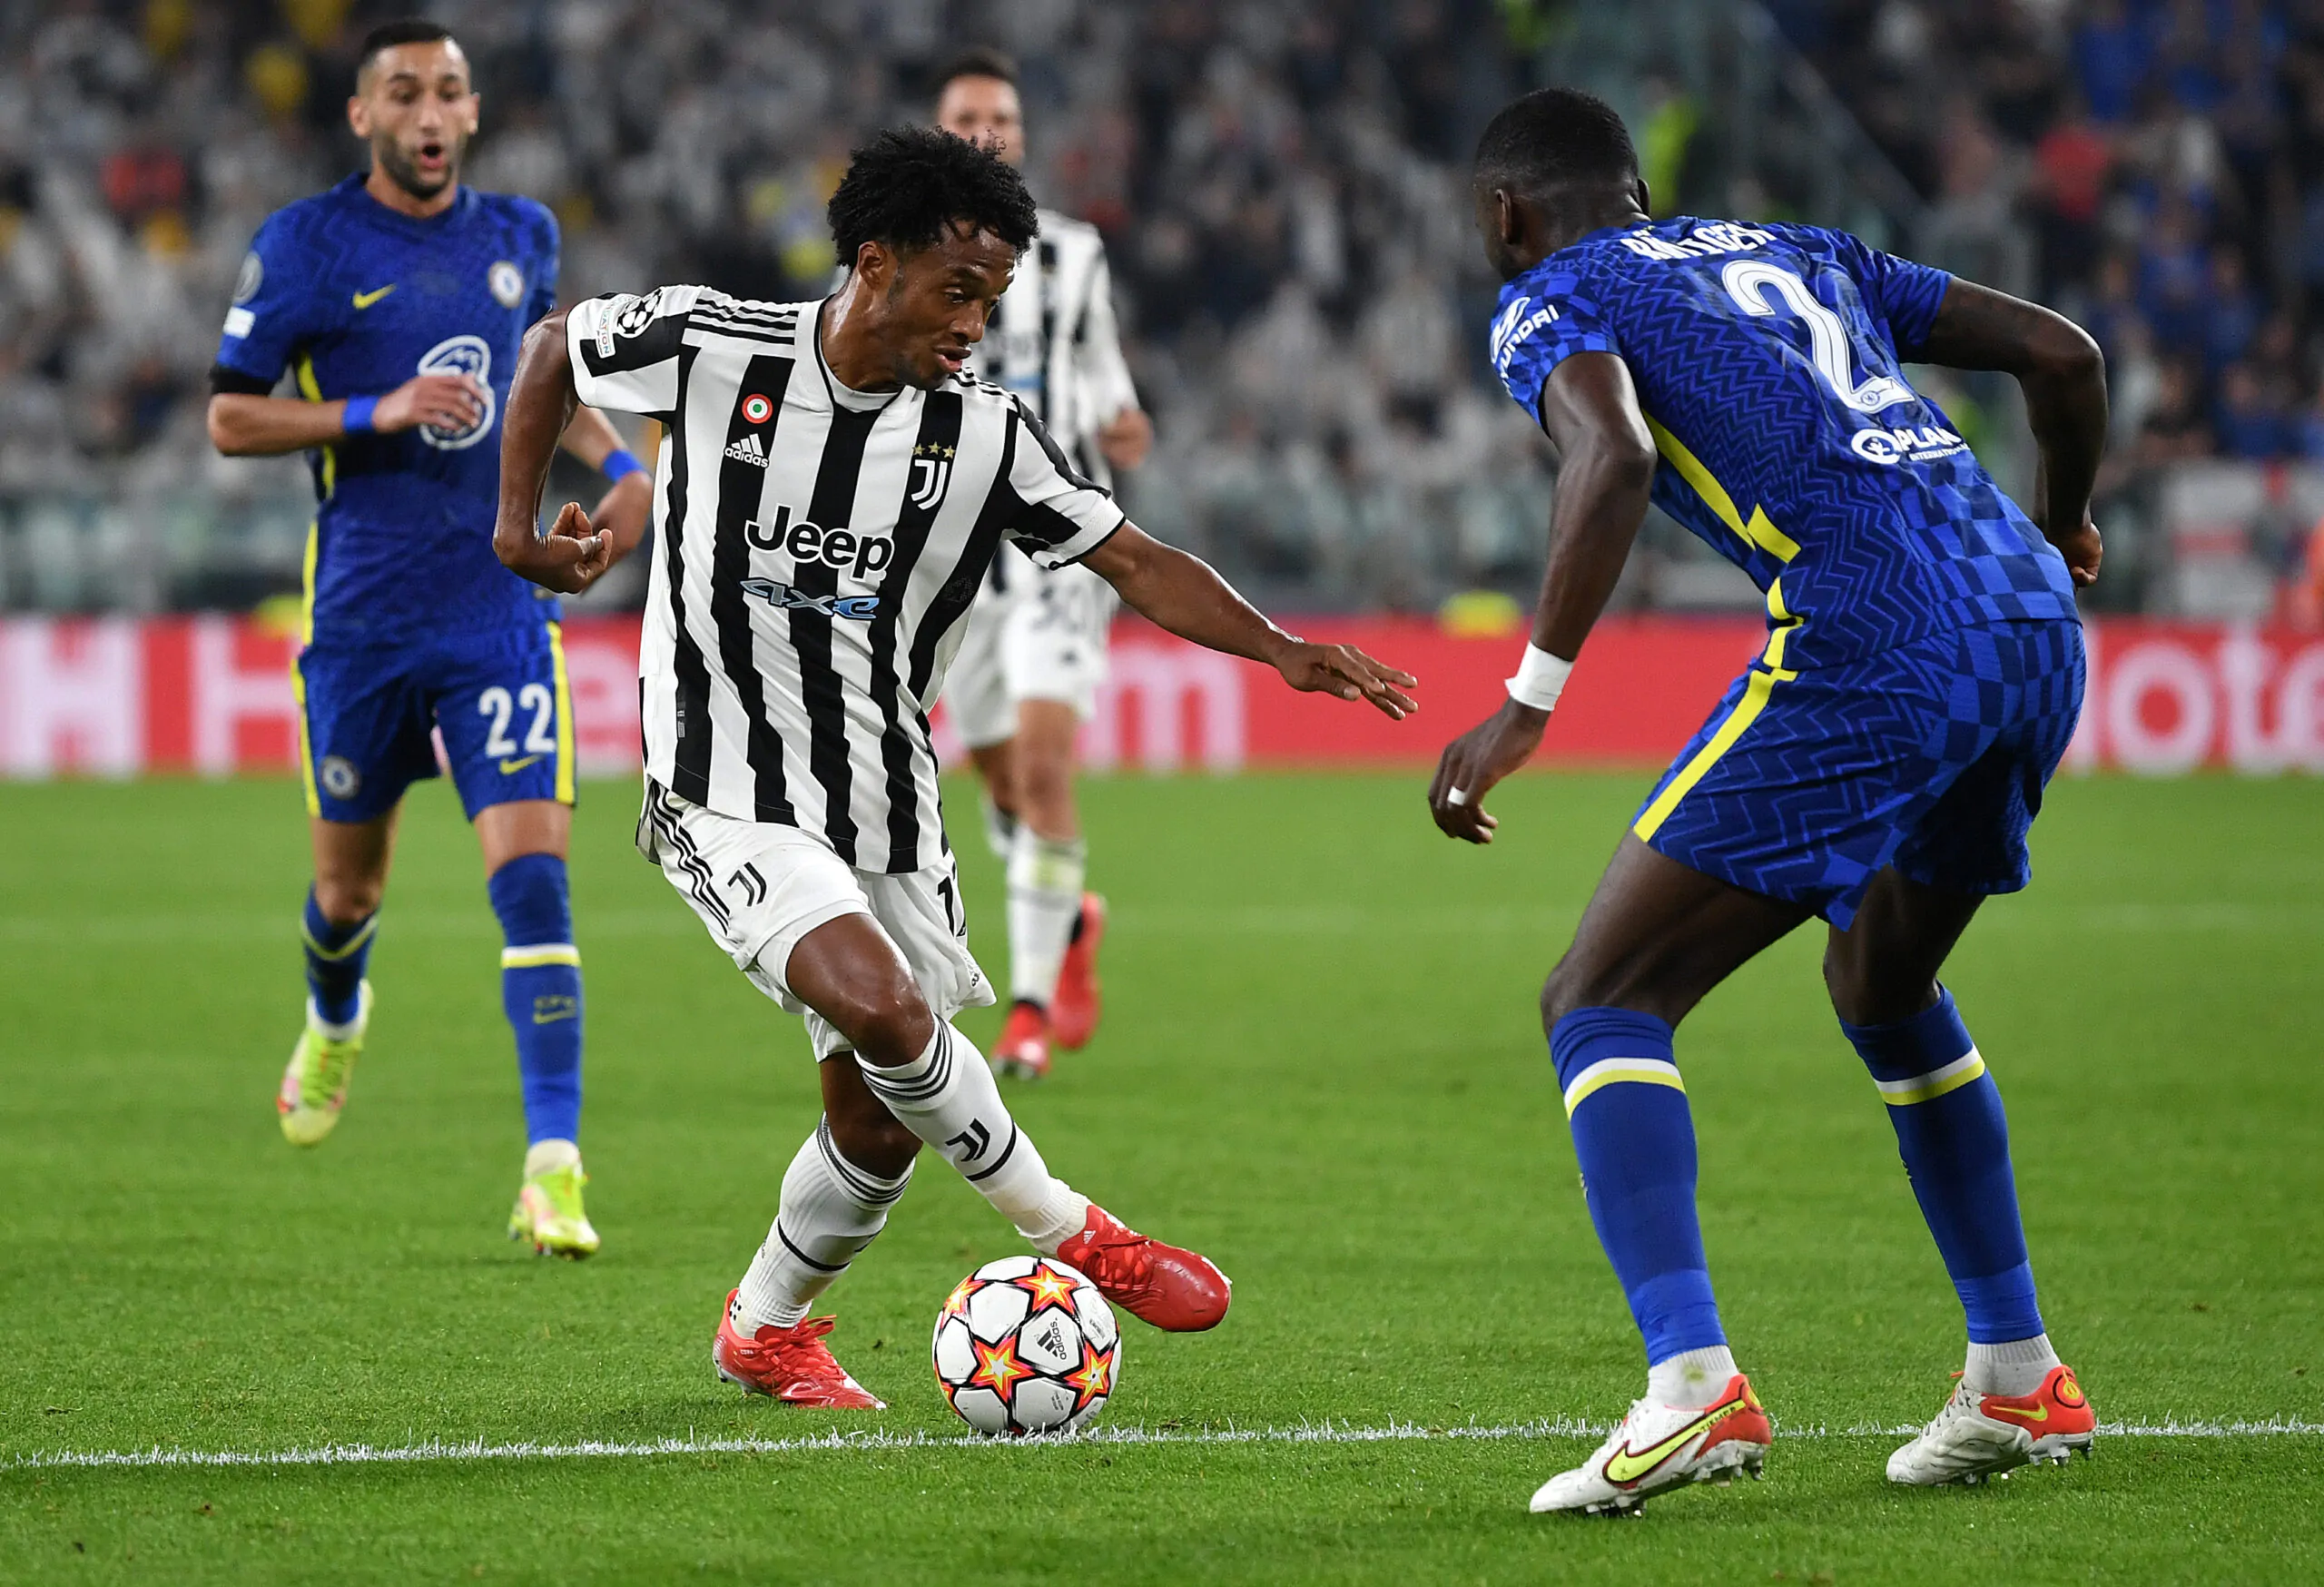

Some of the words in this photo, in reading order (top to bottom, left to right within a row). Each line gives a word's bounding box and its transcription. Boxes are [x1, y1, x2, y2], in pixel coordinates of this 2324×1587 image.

[1722, 259, 1915, 414] 2
[724, 447, 769, 468] adidas
[745, 504, 894, 582] Jeep
[478, 683, 556, 758] 22
[1050, 1321, 1068, 1361] adidas
